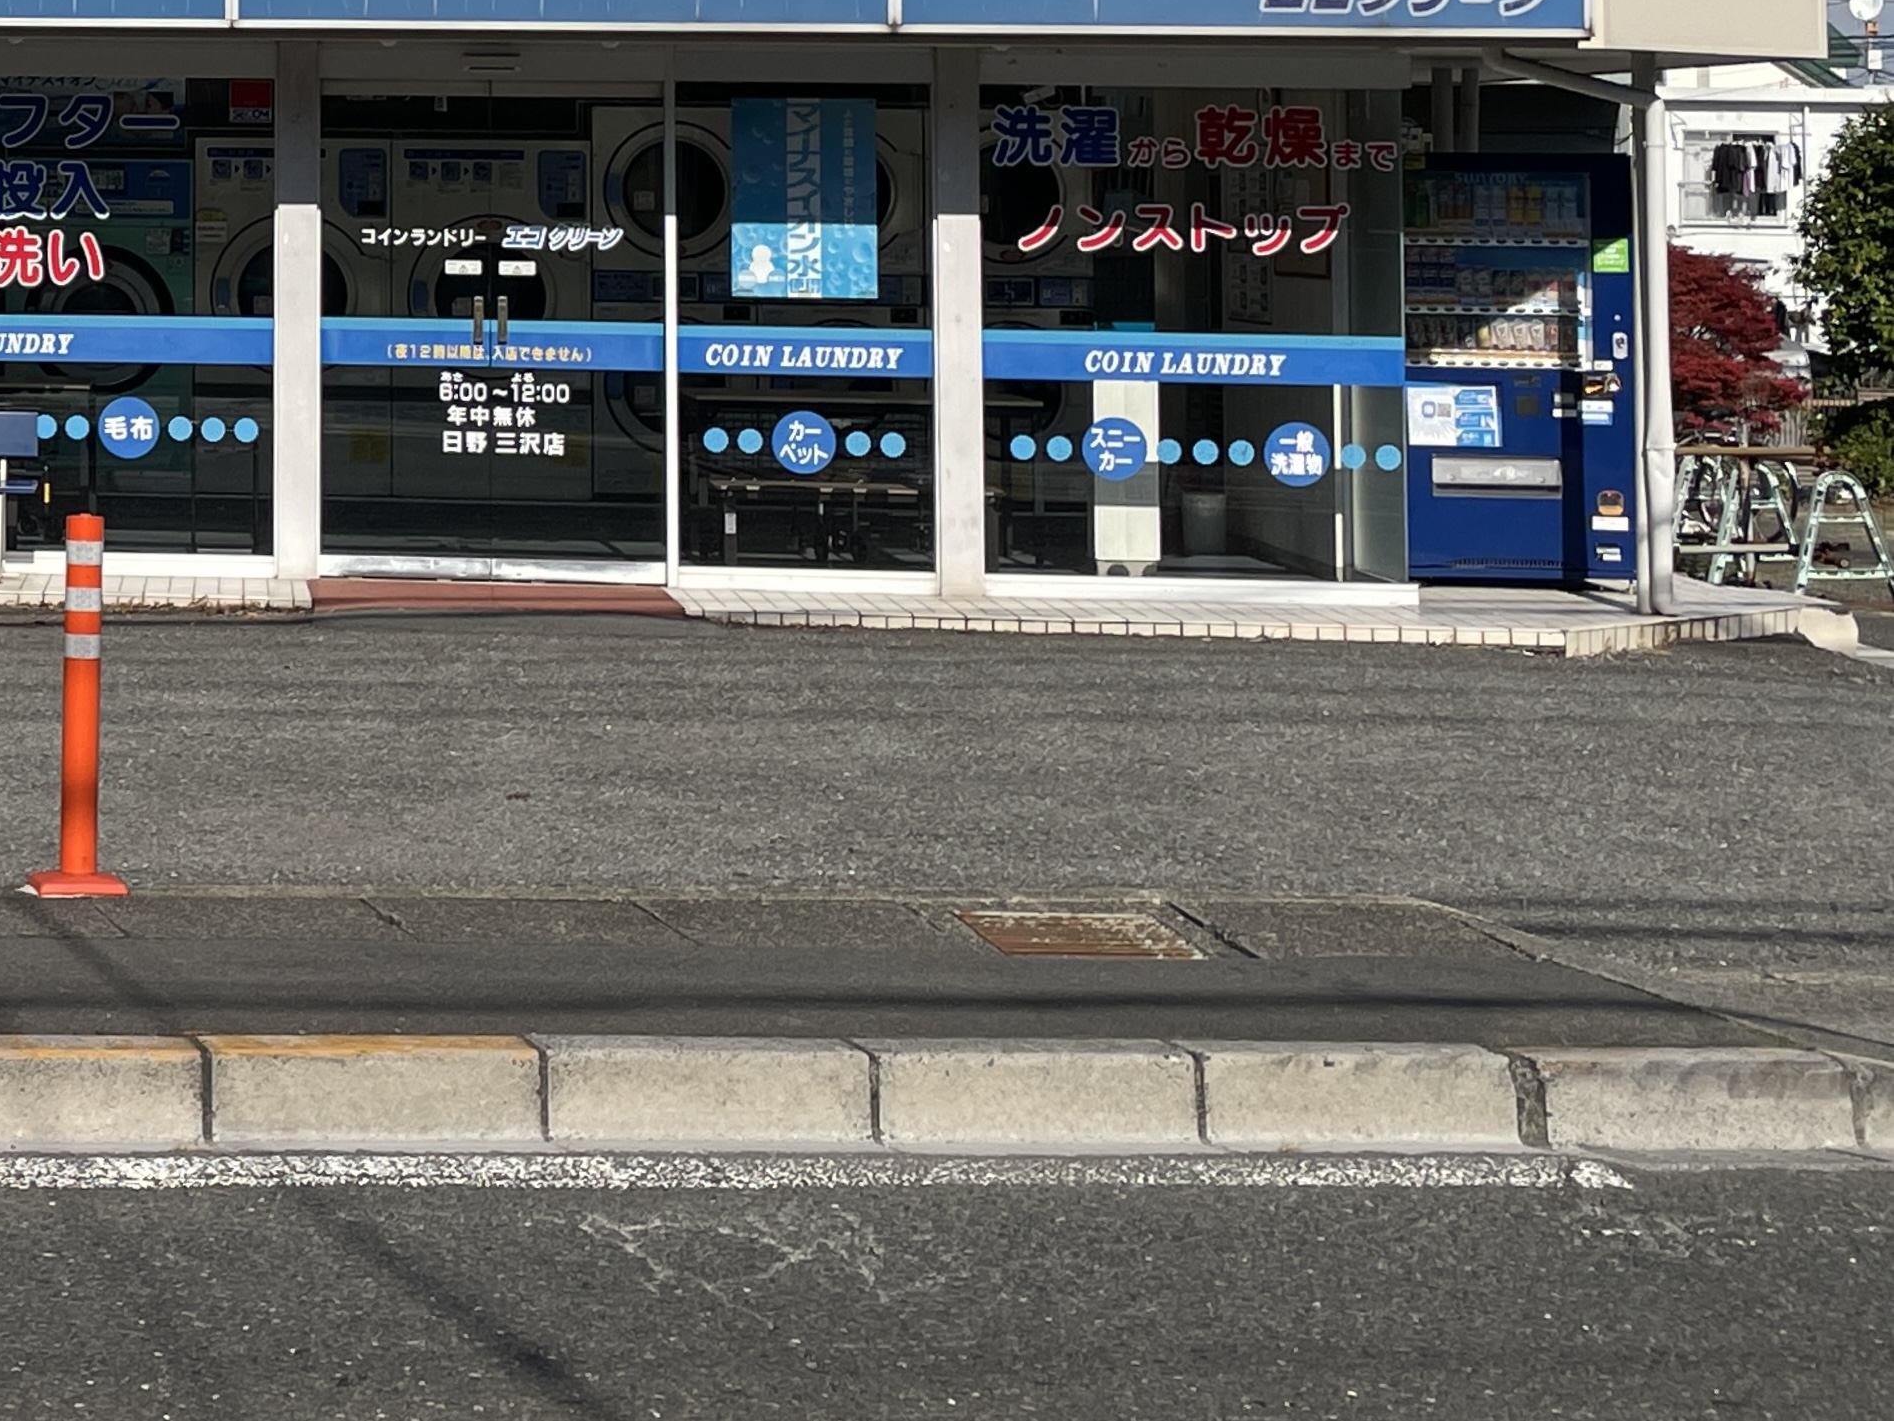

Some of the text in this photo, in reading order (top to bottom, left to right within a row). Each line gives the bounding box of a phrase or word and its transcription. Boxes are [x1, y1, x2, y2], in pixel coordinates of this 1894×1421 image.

[361, 228, 486, 247] コインランドリー
[1017, 204, 1350, 255] ノンストップ
[705, 345, 903, 370] COIN LAUNDRY
[1085, 351, 1286, 377] COIN LAUNDRY
[104, 416, 153, 440] 毛布
[447, 406, 536, 427] 年中無休
[788, 420, 822, 441] カー
[1090, 425, 1141, 449] スニー
[1278, 431, 1315, 453] 一般
[780, 443, 827, 466] ペット
[1099, 450, 1133, 471] カー
[1271, 453, 1323, 477] 洗濯物
